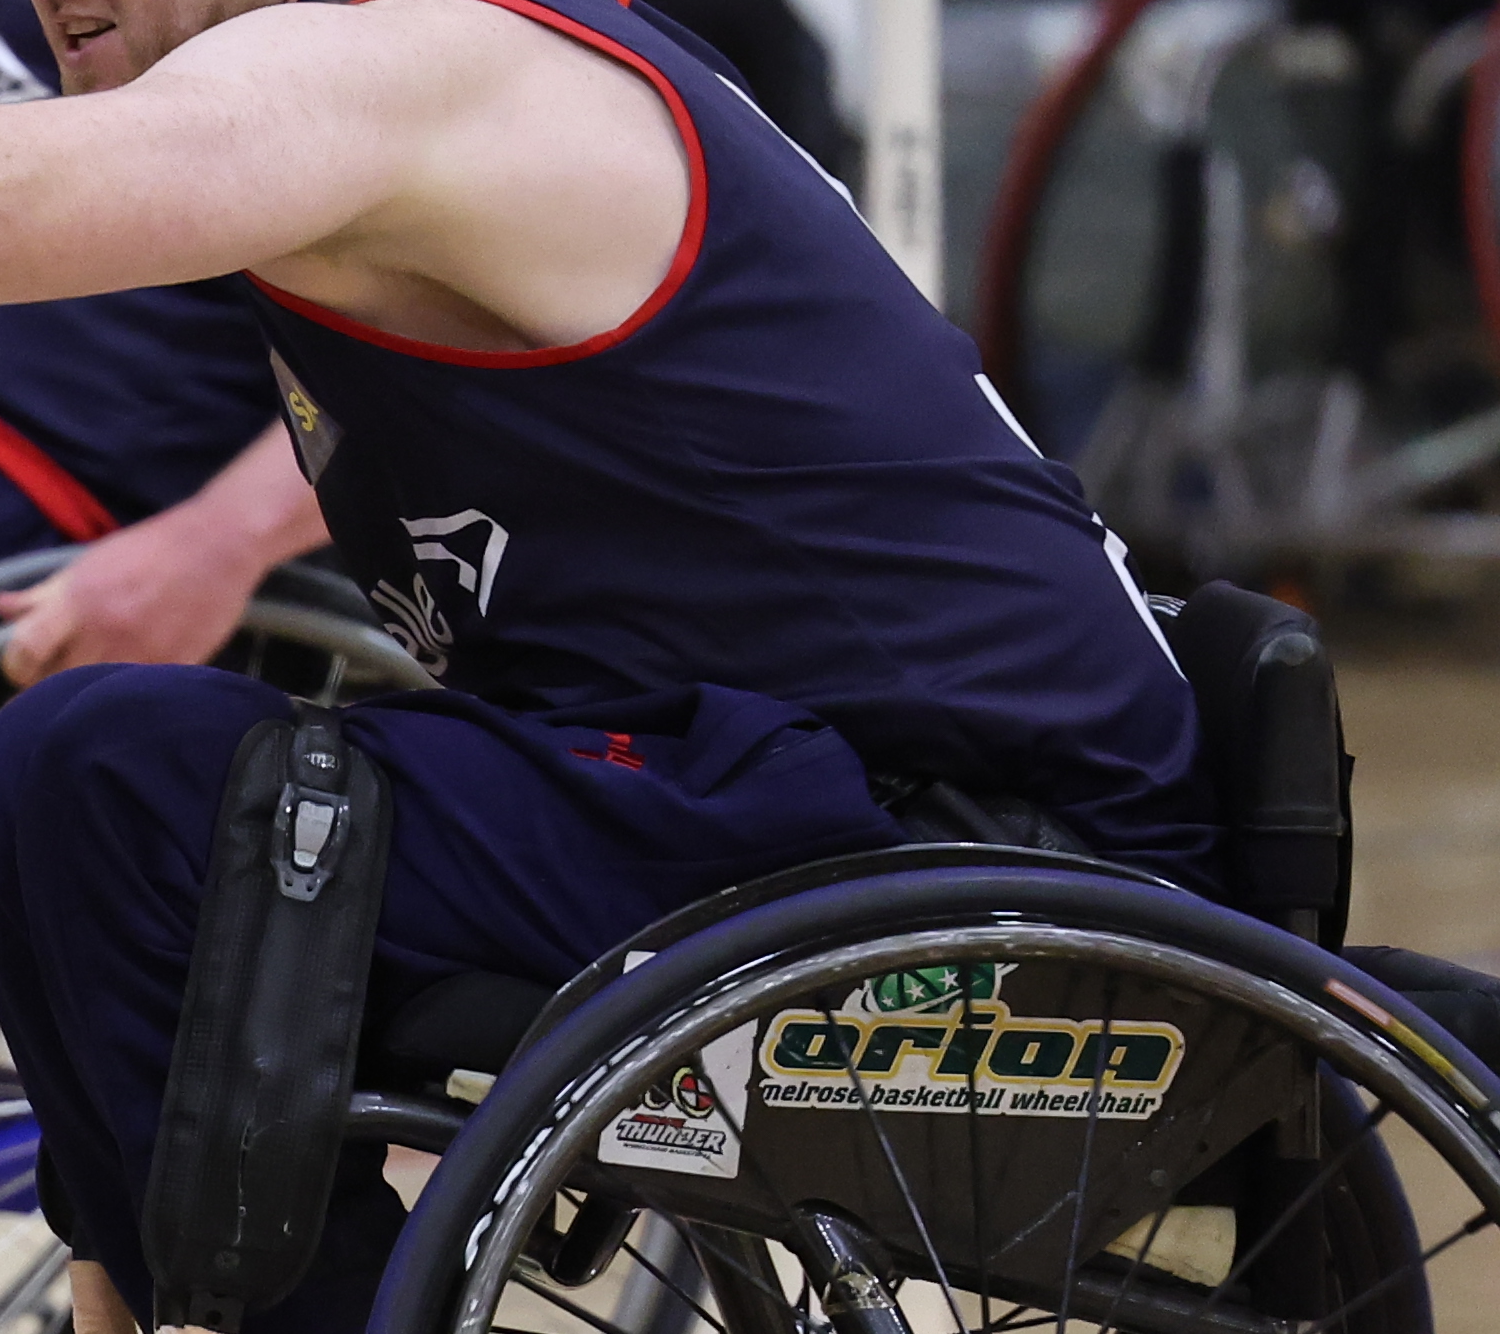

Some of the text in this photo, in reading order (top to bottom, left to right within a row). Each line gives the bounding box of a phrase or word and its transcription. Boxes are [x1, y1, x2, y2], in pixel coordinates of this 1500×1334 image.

[772, 1012, 1172, 1081] orion
[762, 1081, 1156, 1114] melrose basketball wheelchair
[615, 1118, 726, 1156] THUNDER
